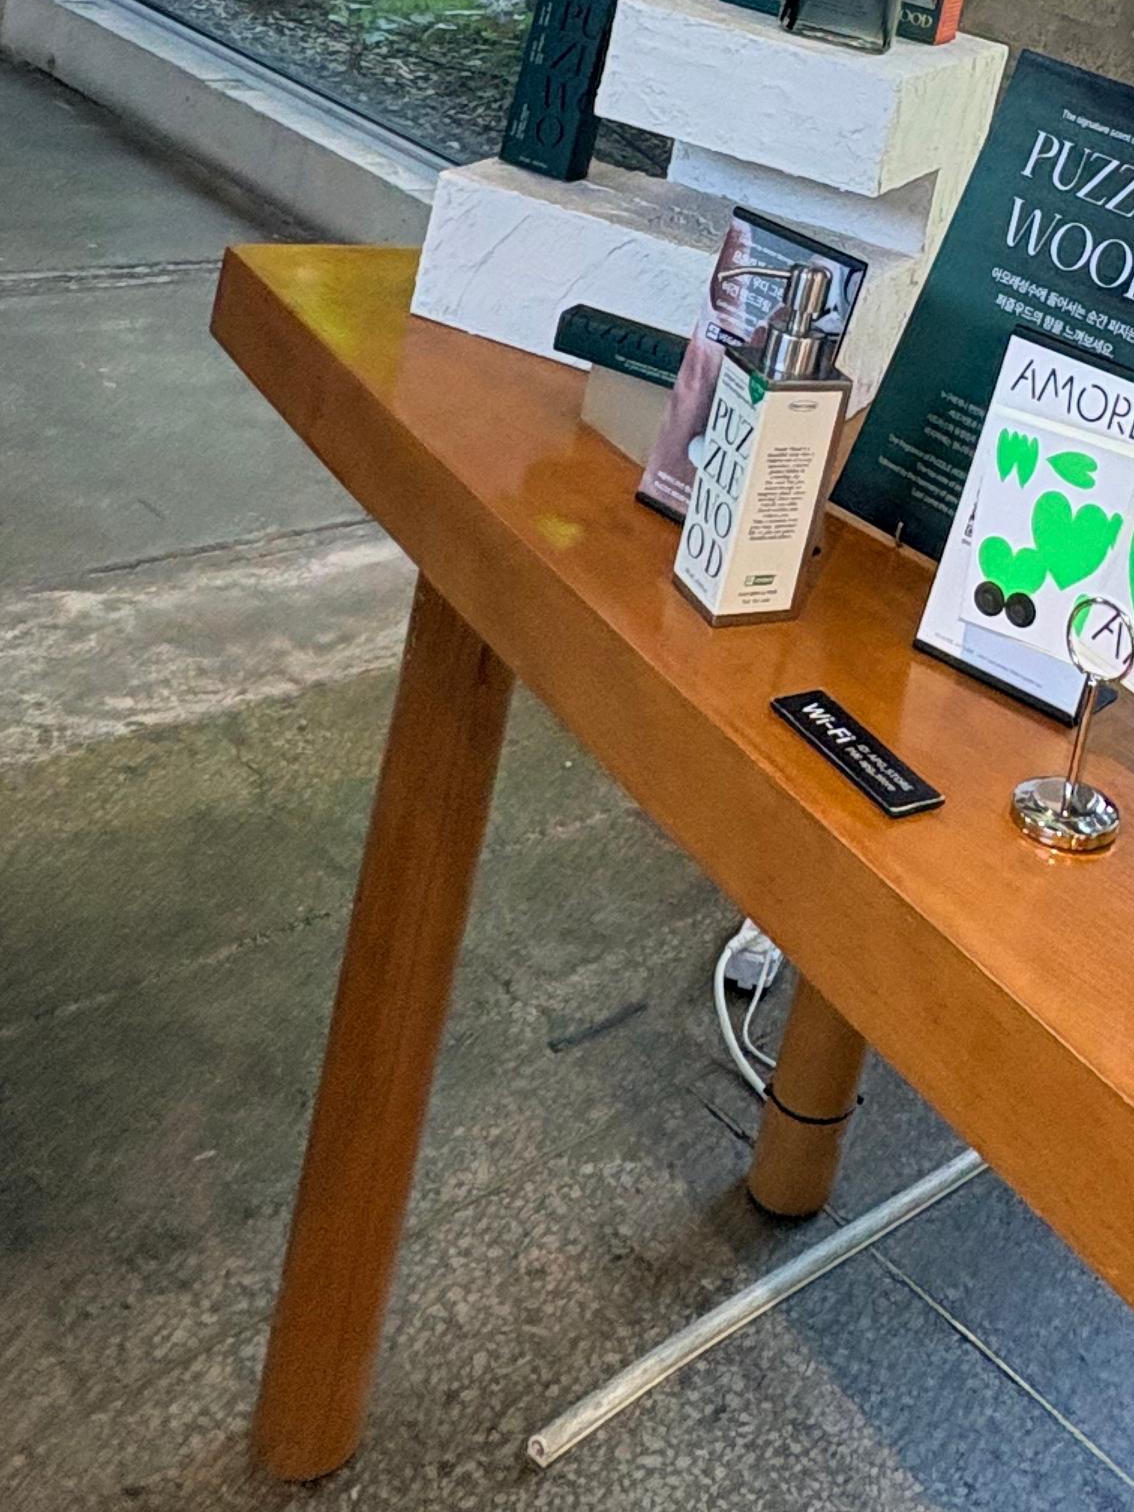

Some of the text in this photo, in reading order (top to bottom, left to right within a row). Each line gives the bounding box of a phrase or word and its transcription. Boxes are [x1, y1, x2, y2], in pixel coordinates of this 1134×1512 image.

[711, 397, 755, 461] PUZ
[703, 438, 745, 501] ZLE
[695, 477, 733, 540] WO
[686, 522, 724, 579] OD
[802, 702, 856, 744] Wi-Fi
